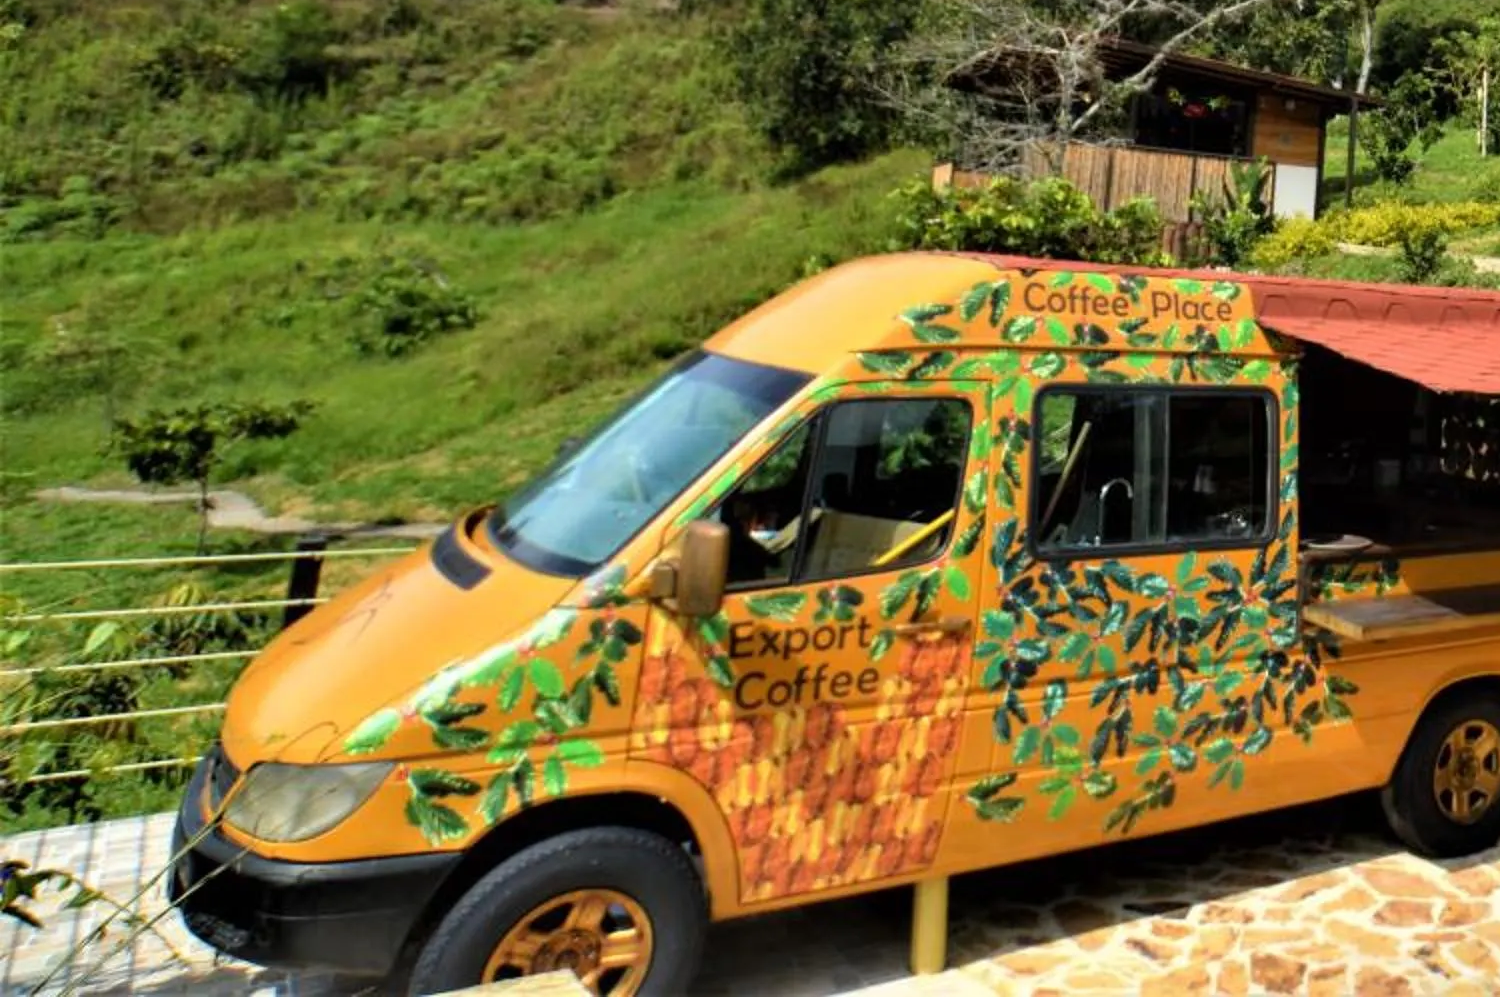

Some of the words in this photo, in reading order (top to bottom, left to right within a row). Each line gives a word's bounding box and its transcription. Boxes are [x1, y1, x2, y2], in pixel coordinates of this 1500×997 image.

[1023, 281, 1130, 321] Coffee
[1150, 290, 1233, 324] Place
[730, 614, 873, 662] Export
[734, 663, 882, 712] Coffee
